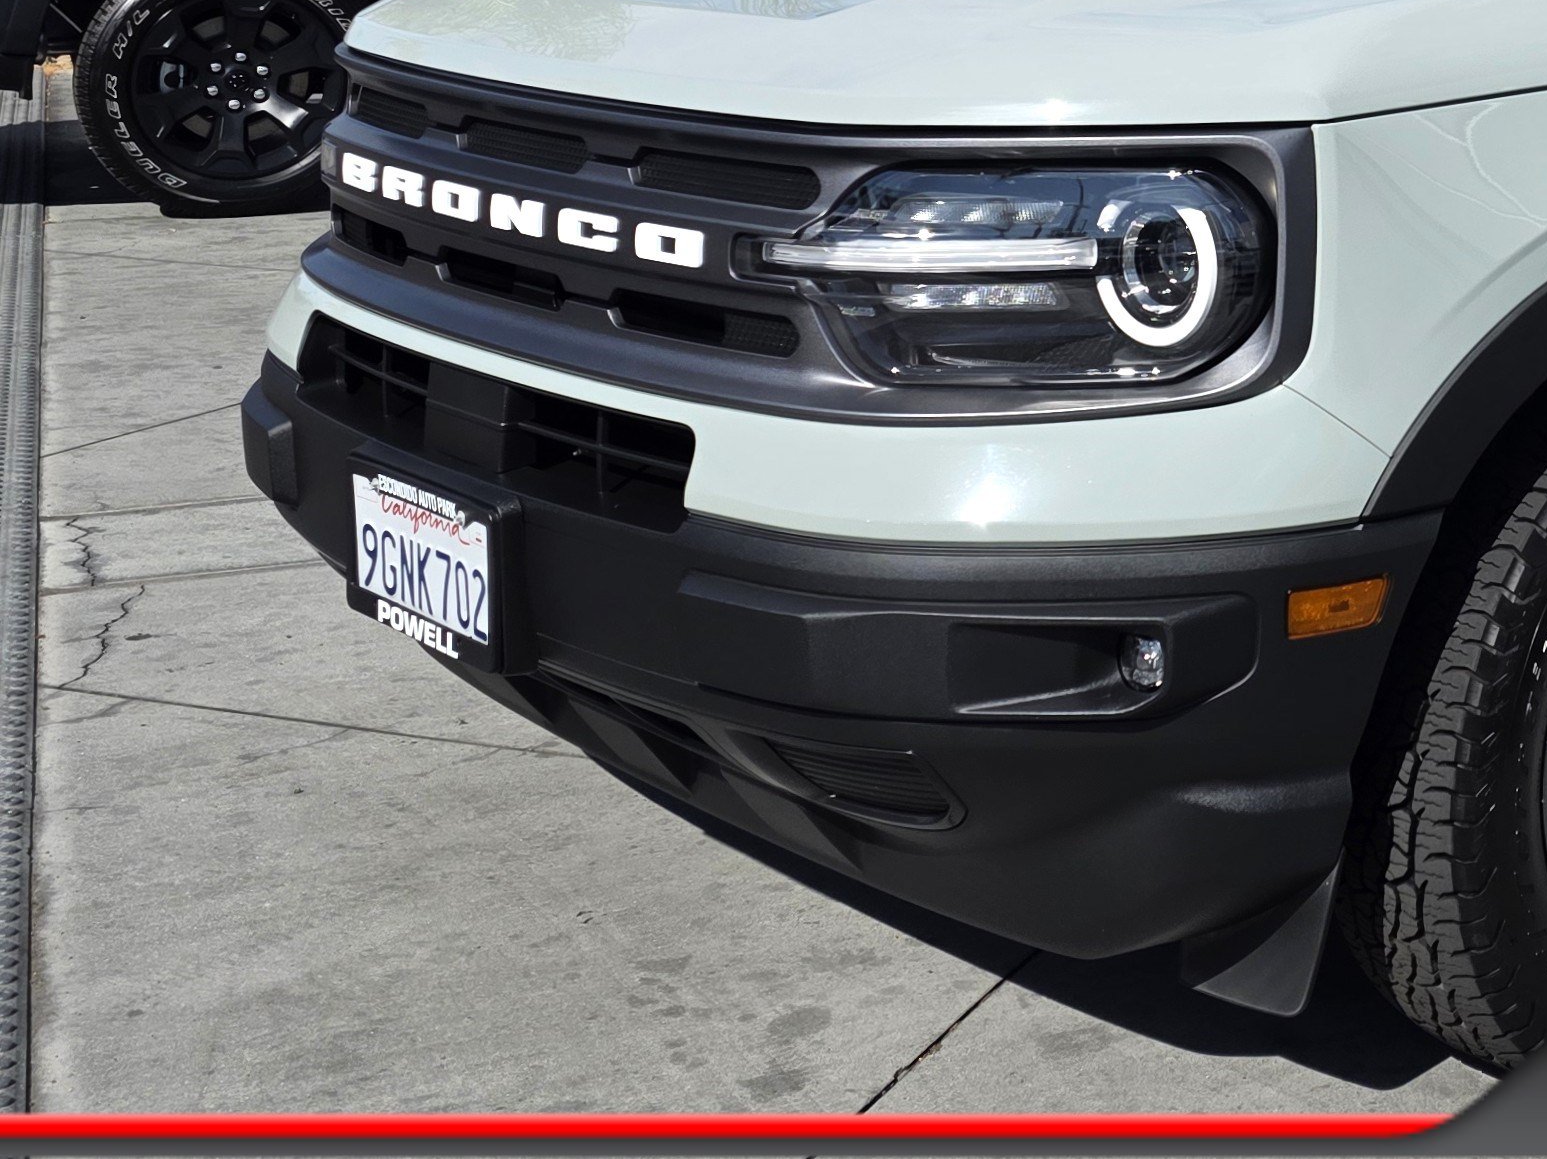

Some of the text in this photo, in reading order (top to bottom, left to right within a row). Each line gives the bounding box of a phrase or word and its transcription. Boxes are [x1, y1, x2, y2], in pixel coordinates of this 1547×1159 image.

[341, 152, 704, 268] BRONCO
[381, 494, 470, 545] California
[418, 489, 437, 512] AUTO
[437, 496, 457, 519] PARK
[362, 523, 488, 641] 9GNK702
[377, 598, 459, 659] POWELL
